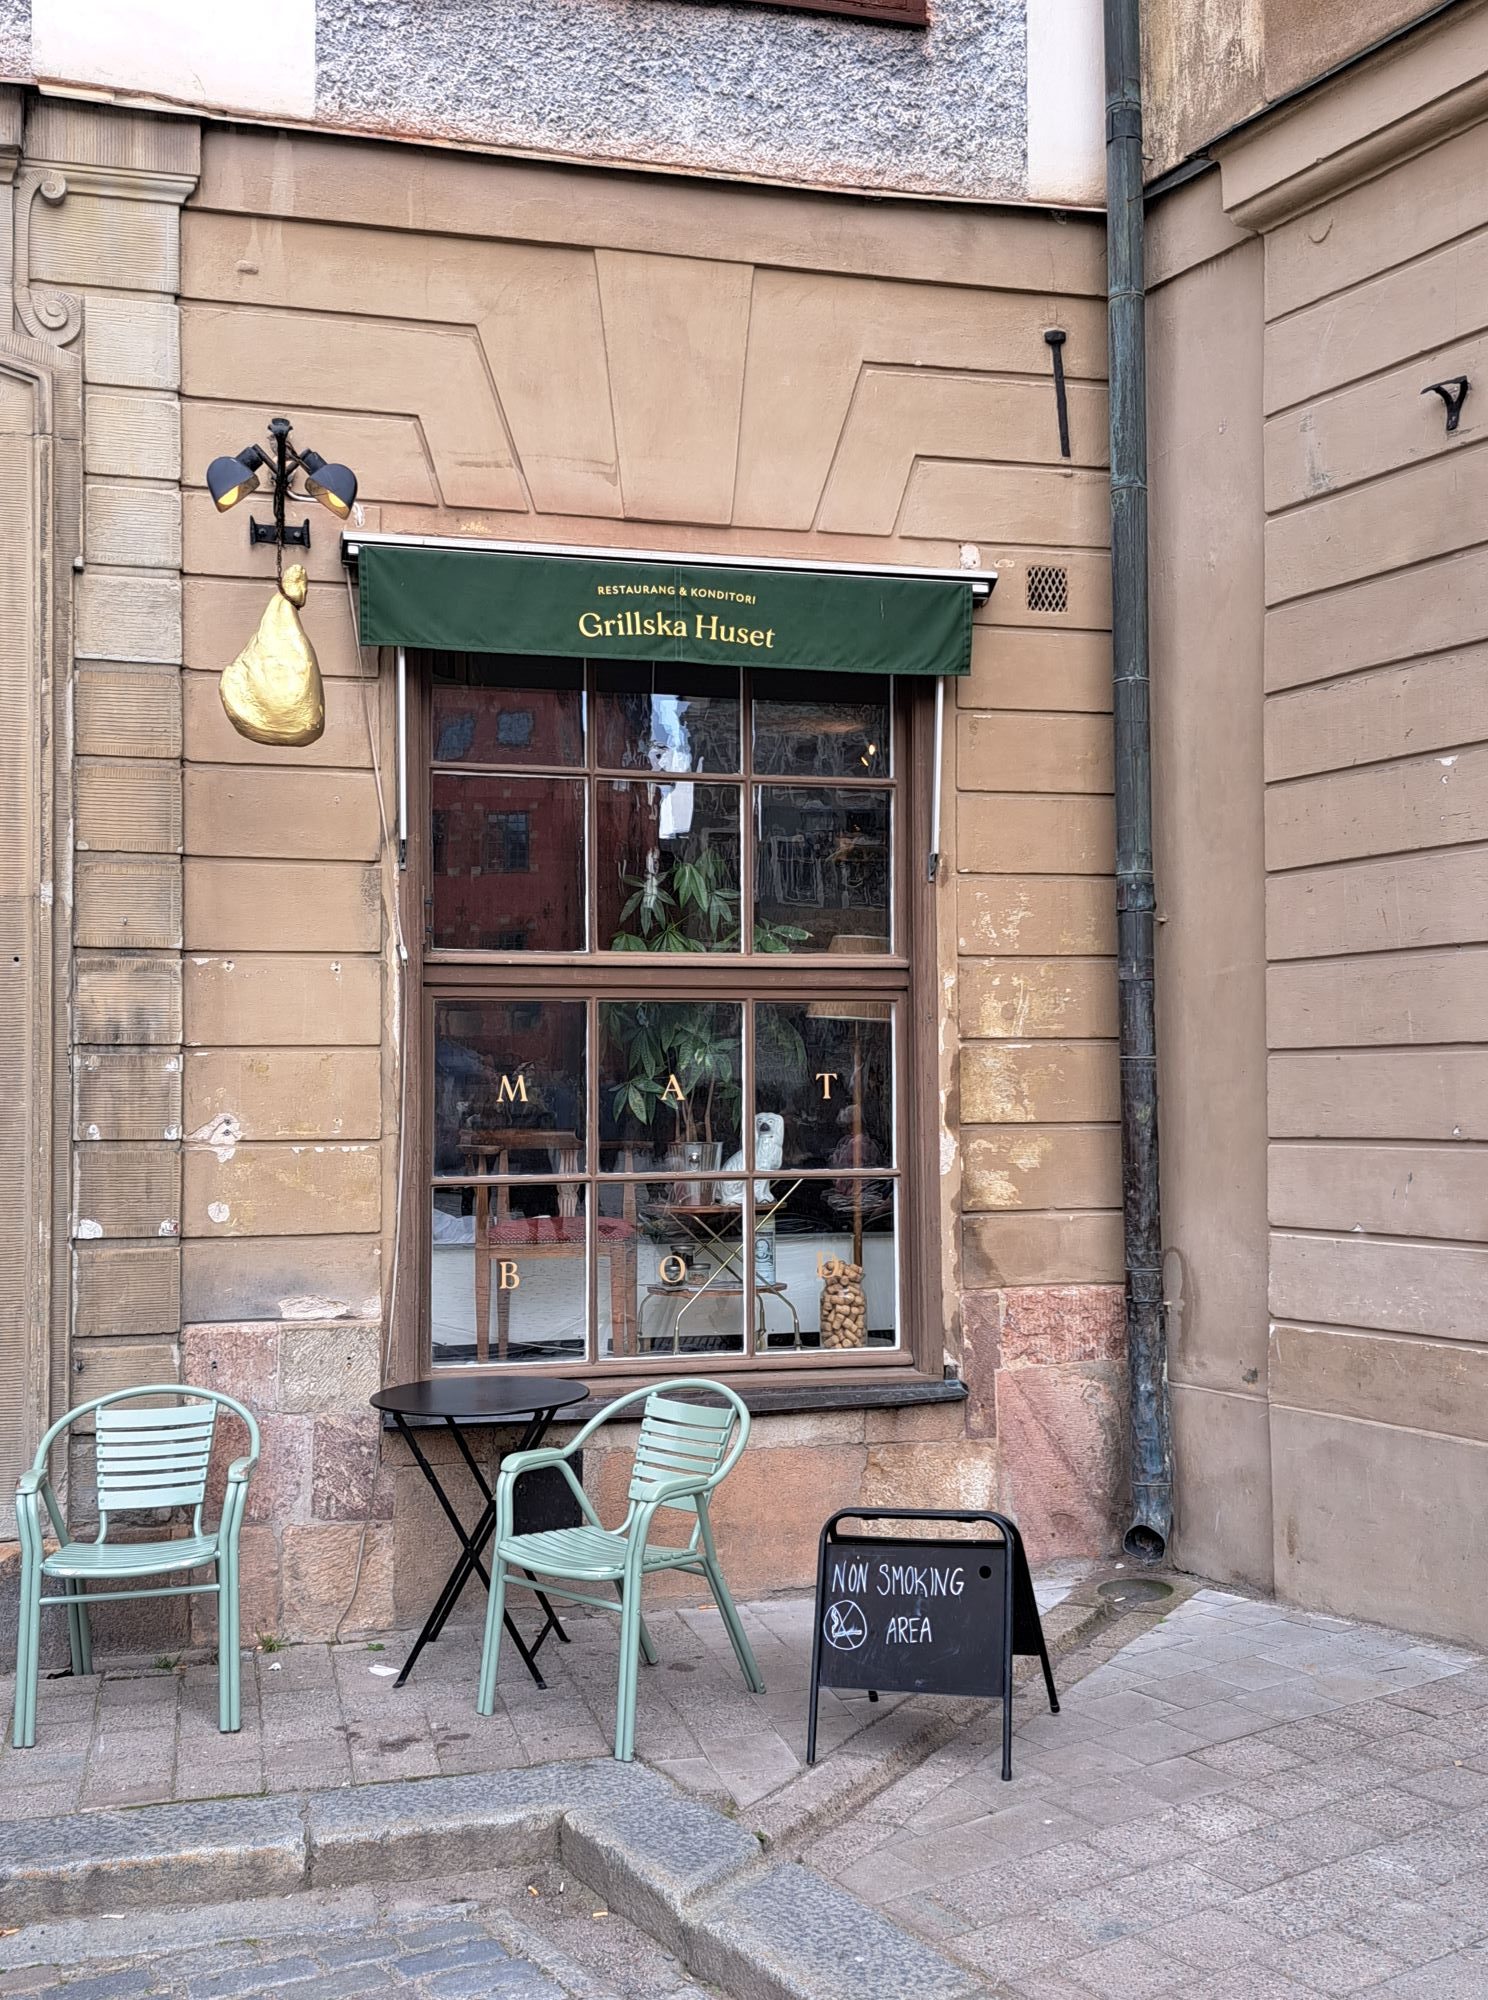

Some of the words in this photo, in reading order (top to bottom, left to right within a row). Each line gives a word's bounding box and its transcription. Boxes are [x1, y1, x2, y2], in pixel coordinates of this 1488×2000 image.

[597, 584, 676, 596] RESTAURANG
[679, 585, 688, 597] &
[690, 587, 757, 605] KONDITORI
[578, 610, 688, 638] Grillska
[695, 613, 776, 649] Huset
[831, 1560, 869, 1594] NON
[876, 1563, 965, 1598] SMOKING
[885, 1616, 933, 1645] AREA
